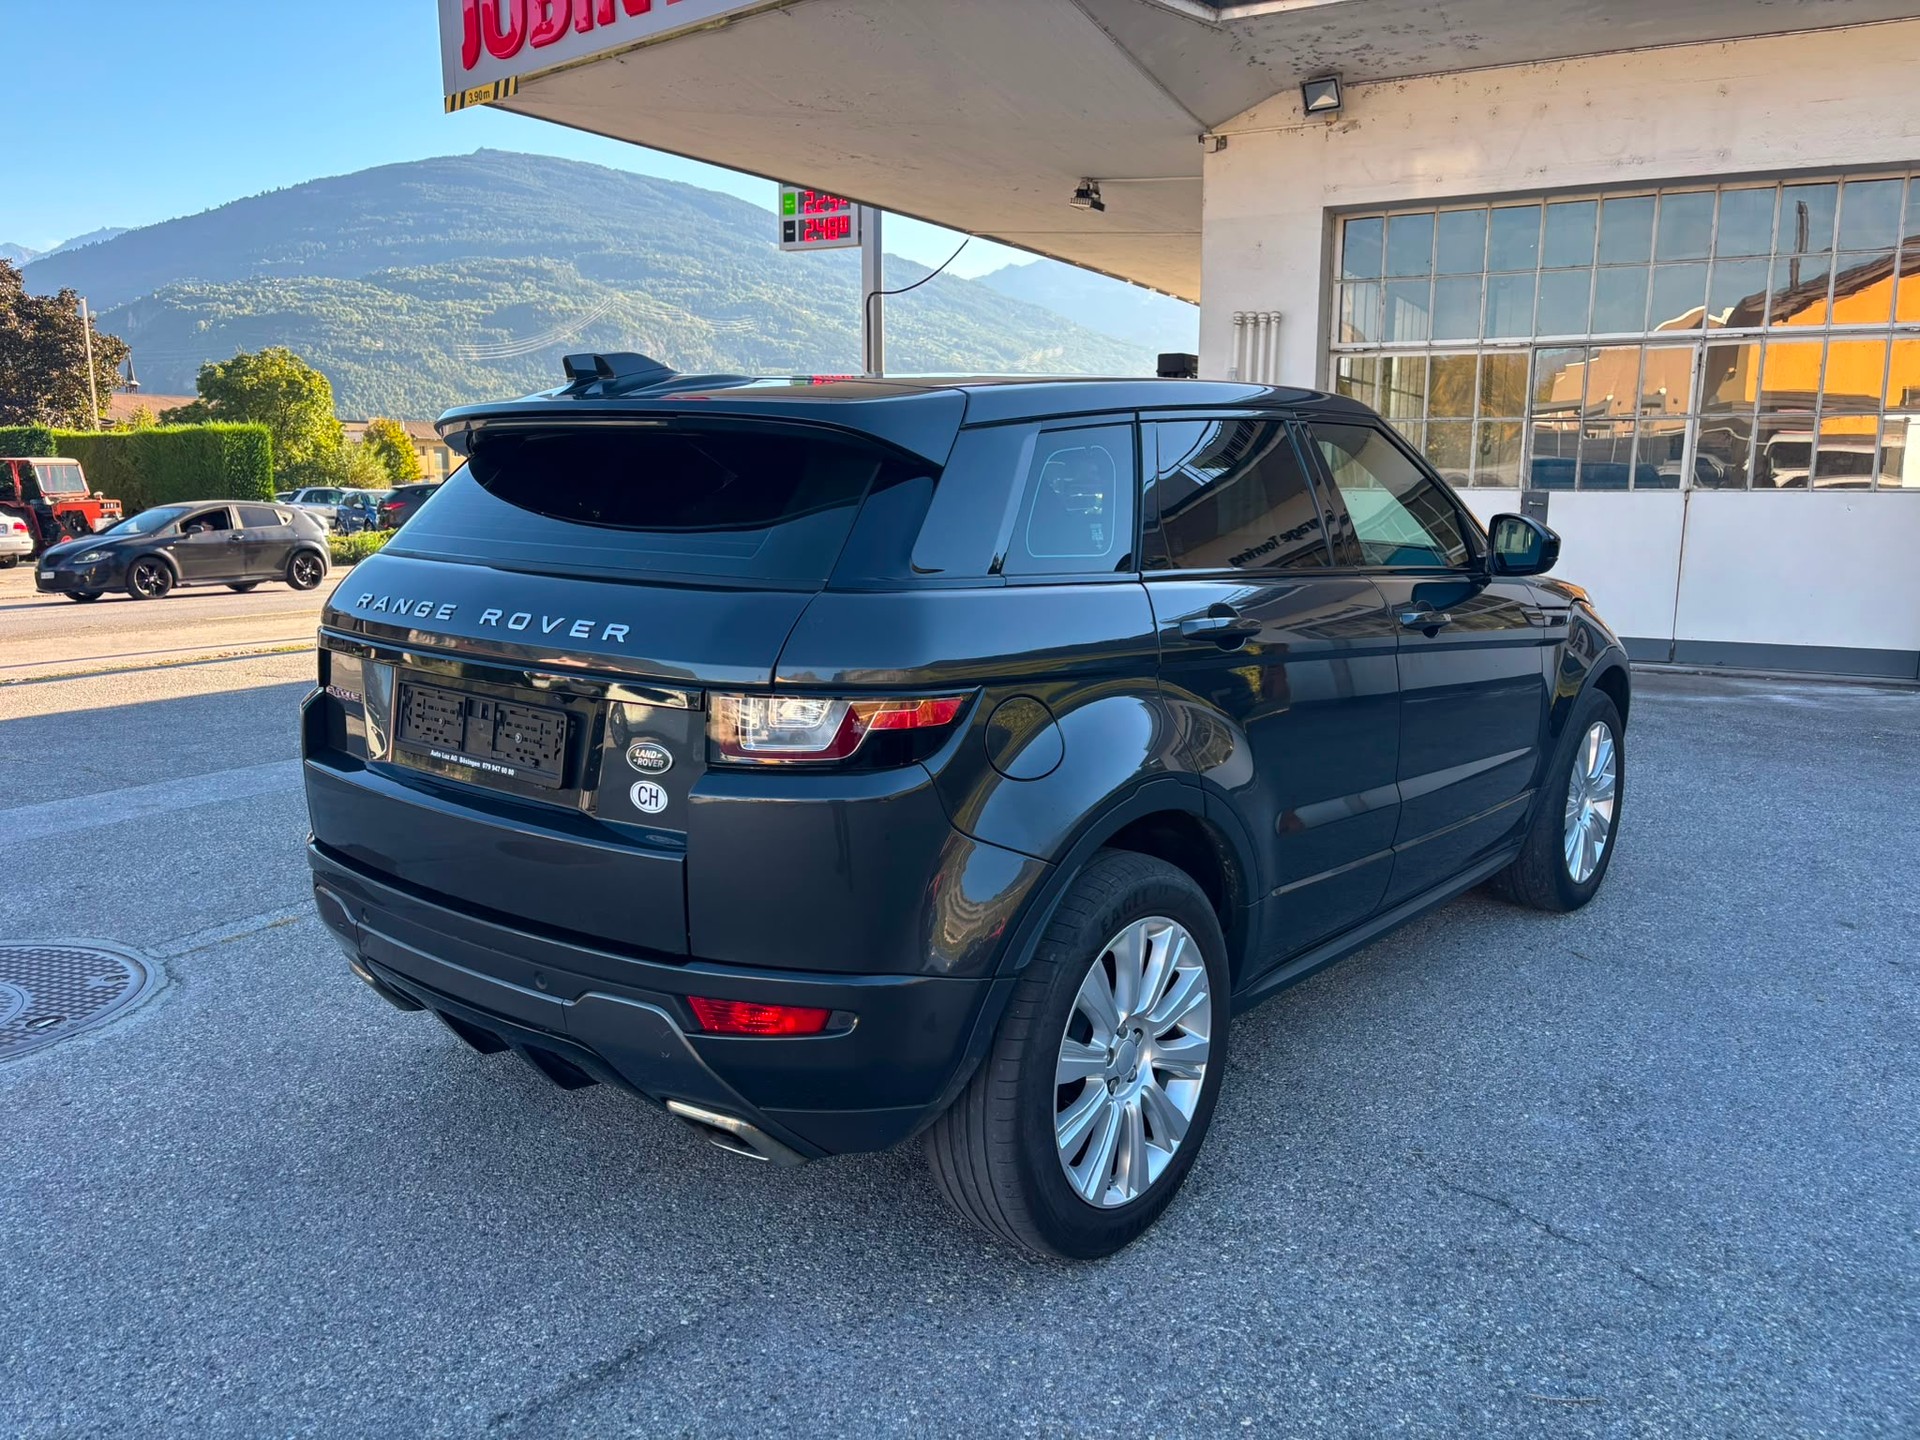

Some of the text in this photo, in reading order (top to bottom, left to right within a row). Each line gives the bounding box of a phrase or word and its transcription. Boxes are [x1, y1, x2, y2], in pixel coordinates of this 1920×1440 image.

[356, 592, 630, 643] RANGE ROVER
[430, 749, 441, 758] Auto
[635, 748, 658, 759] LAND
[636, 757, 664, 768] ROVER
[638, 785, 659, 808] CH
